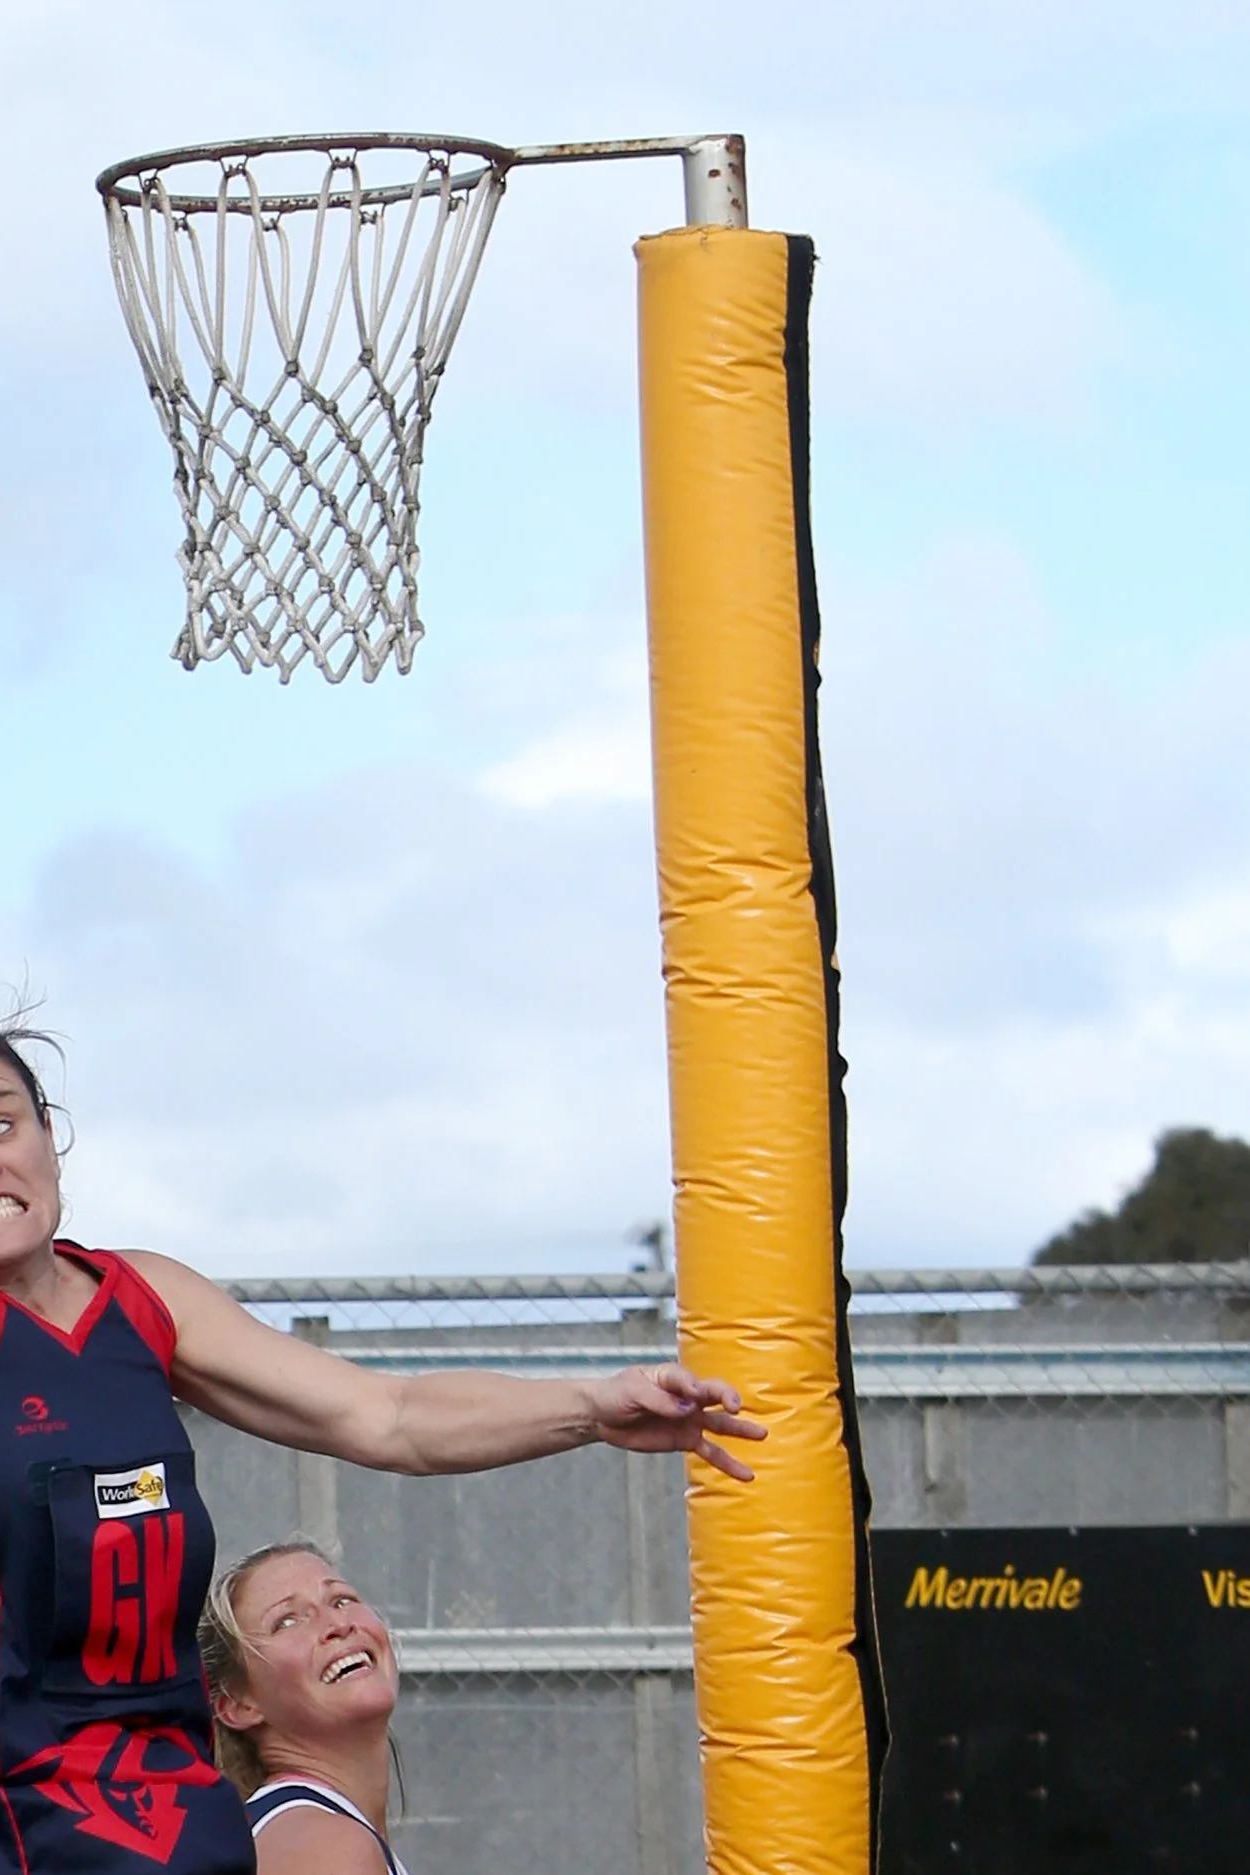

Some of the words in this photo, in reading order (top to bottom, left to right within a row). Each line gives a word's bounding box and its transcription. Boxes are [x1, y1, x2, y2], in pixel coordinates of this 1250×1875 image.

[82, 1511, 184, 1686] GK
[905, 1564, 1083, 1611] Merrivale
[1200, 1569, 1250, 1609] Vis
